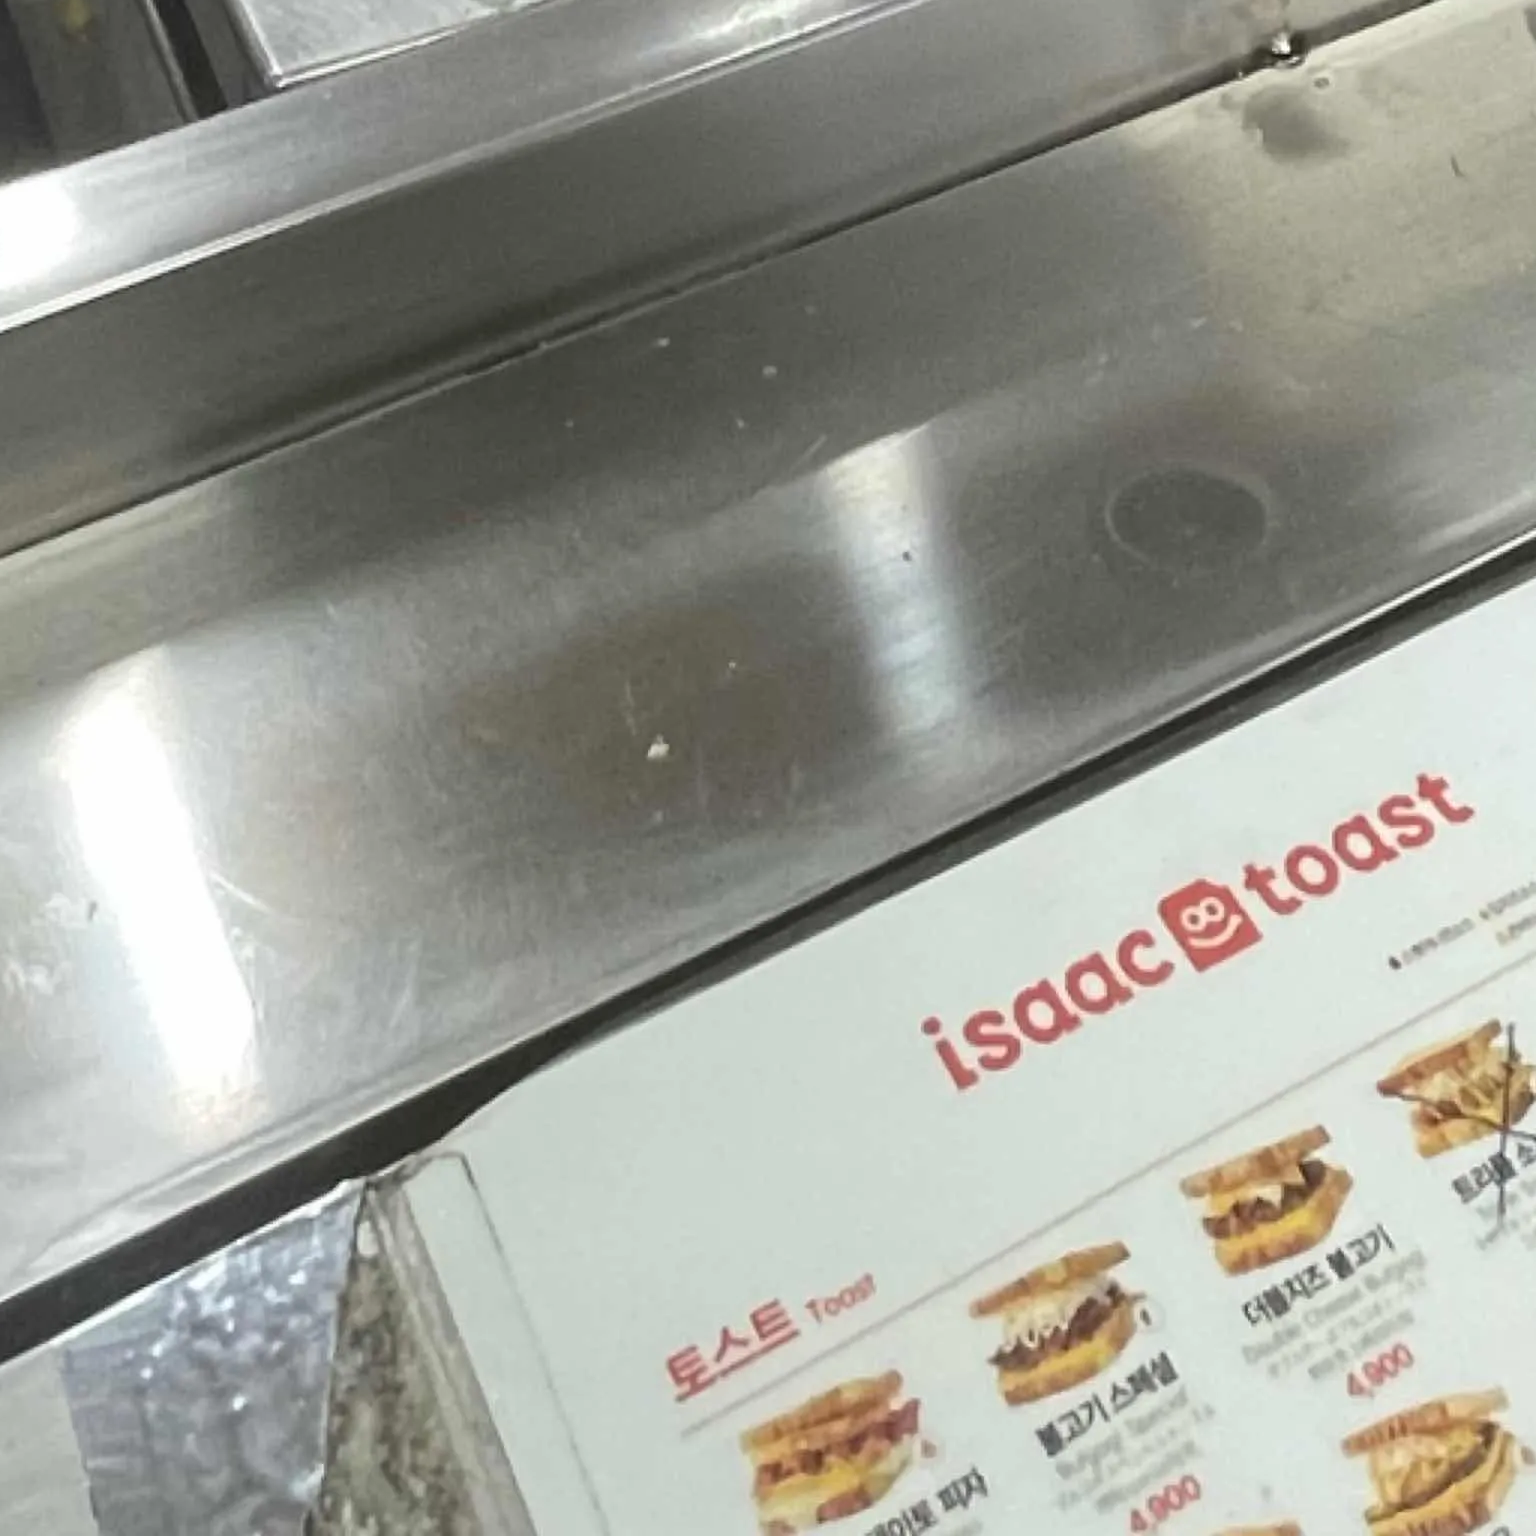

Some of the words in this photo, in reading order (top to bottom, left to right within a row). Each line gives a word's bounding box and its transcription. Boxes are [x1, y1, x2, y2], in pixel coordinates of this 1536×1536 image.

[921, 930, 1175, 1091] isaac
[1241, 771, 1476, 917] toast
[1326, 1223, 1396, 1281] 불고기
[665, 1299, 801, 1404] 토스트
[805, 1272, 878, 1324] Toast
